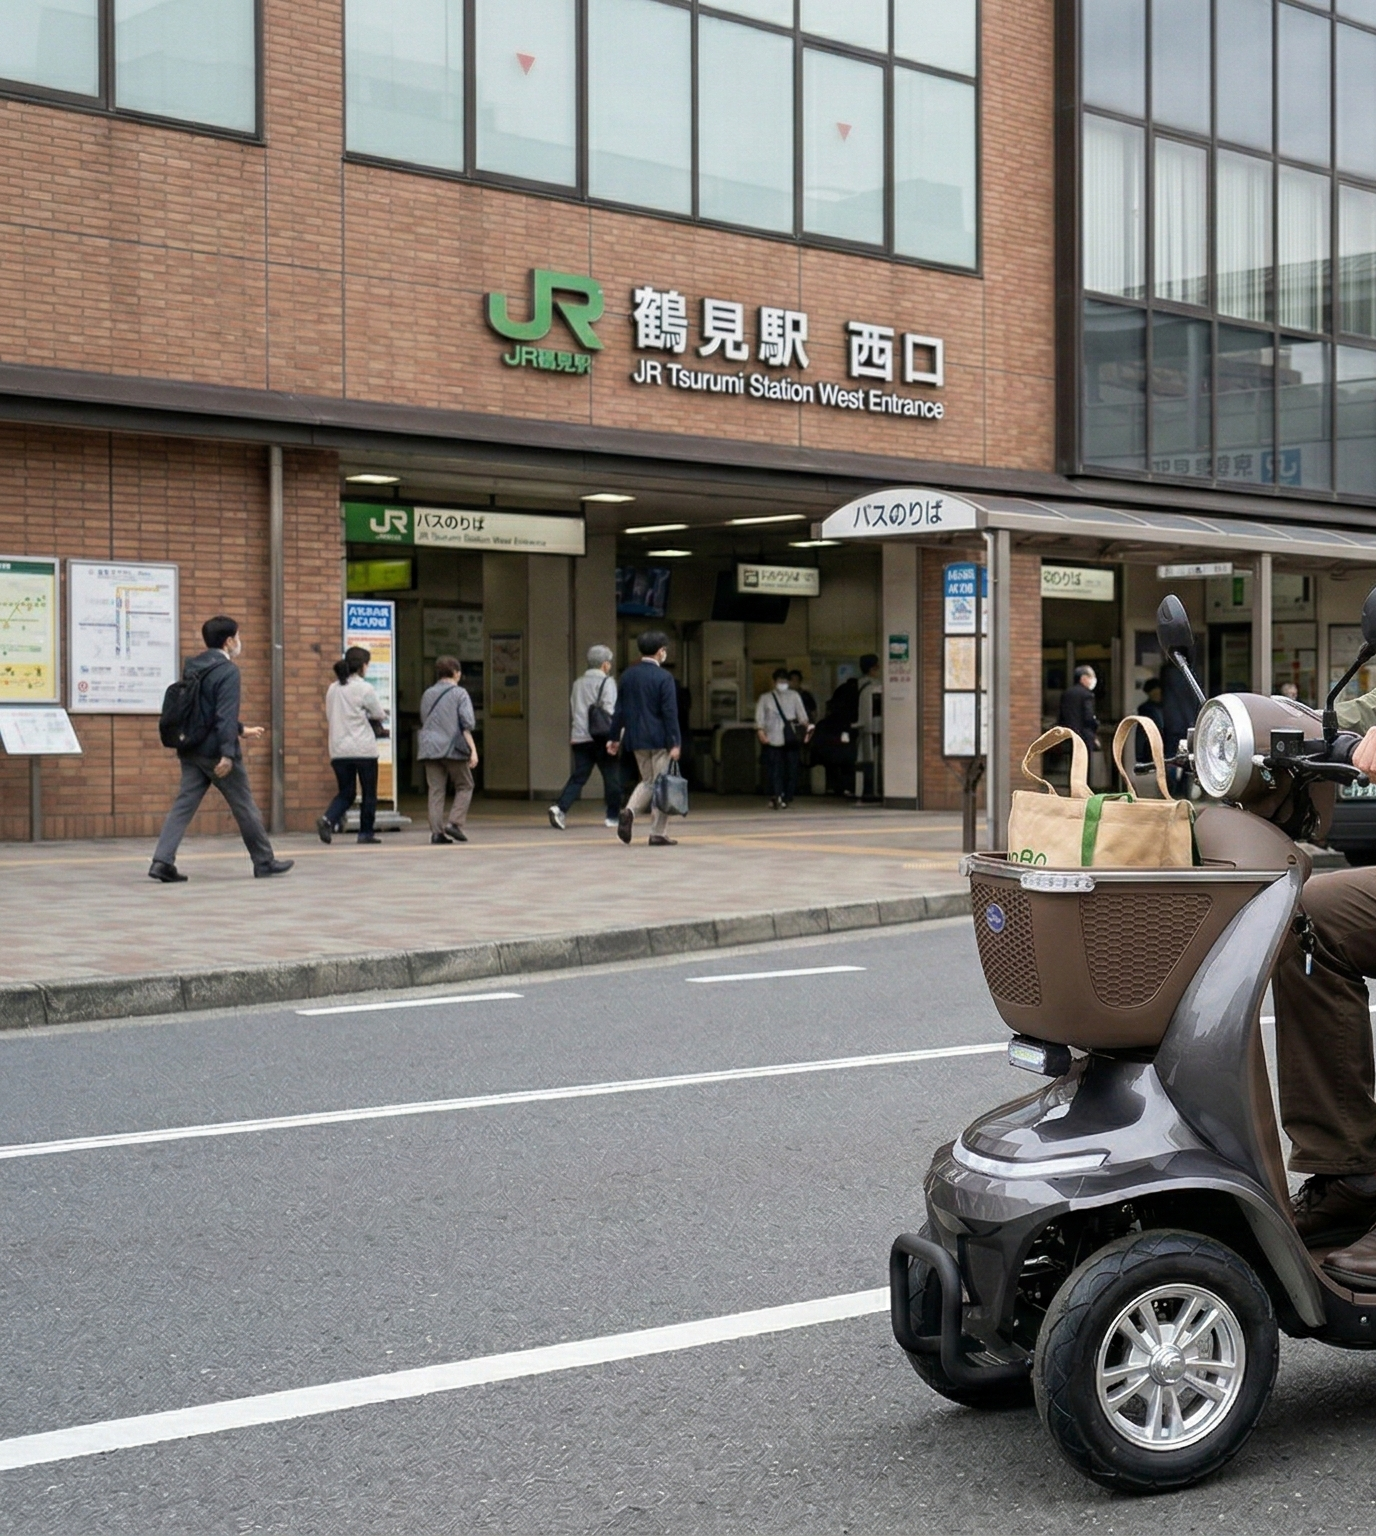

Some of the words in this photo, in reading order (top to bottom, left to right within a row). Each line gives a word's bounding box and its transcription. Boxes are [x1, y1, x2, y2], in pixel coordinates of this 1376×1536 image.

[487, 268, 605, 350] JR
[633, 286, 810, 369] 鶴見駅
[848, 321, 944, 386] 西口
[633, 359, 662, 385] JR
[666, 363, 745, 394] Tsurumi
[749, 373, 814, 403] Station
[818, 382, 865, 410] West
[868, 389, 944, 419] Entrance
[370, 509, 408, 533] JR
[417, 513, 485, 531] バスのりば
[853, 500, 943, 528] バスのりば
